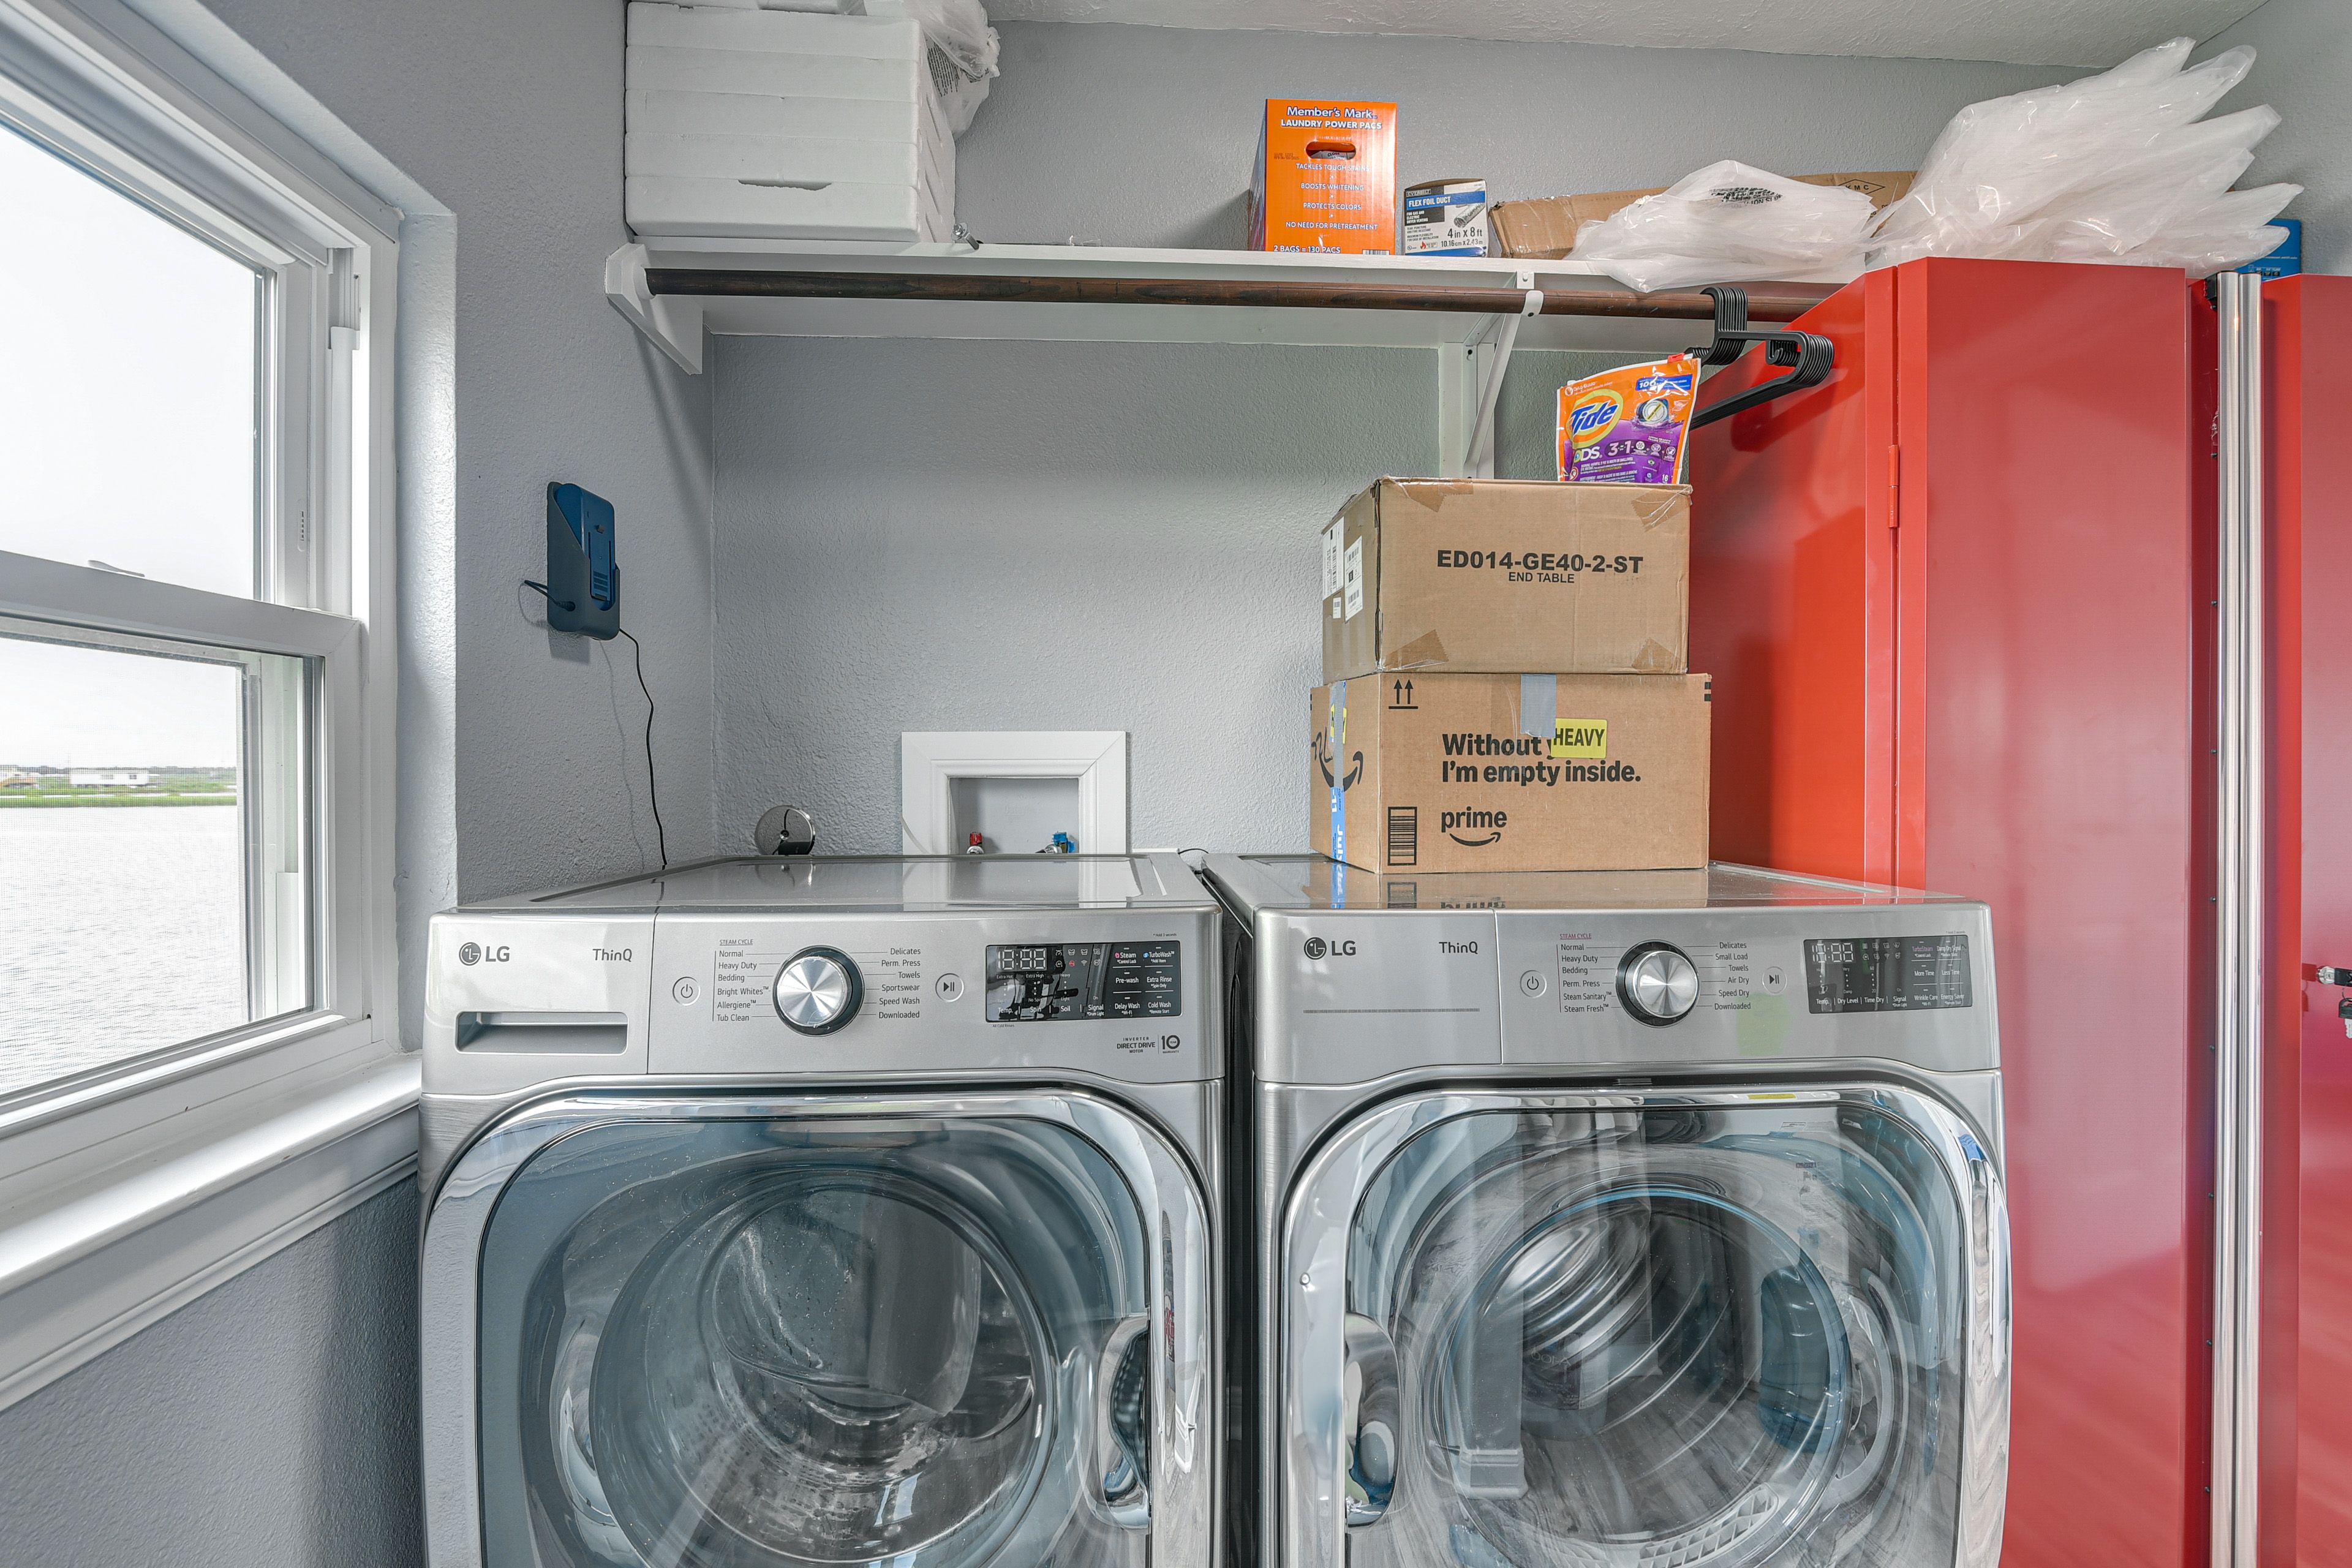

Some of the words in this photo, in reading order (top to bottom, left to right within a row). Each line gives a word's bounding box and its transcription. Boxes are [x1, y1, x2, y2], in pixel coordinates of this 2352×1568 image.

[1287, 106, 1340, 117] Member's
[1409, 199, 1422, 208] FLEX
[1448, 228, 1453, 238] 4
[1470, 227, 1475, 237] 8
[1570, 400, 1619, 436] Tide
[1437, 549, 1643, 574] ED014-GE40-2-ST
[1509, 571, 1532, 582] END
[1537, 572, 1575, 584] TABLE
[1555, 728, 1605, 747] HEAVY
[1442, 733, 1542, 756] Without
[1442, 761, 1477, 782] I'm
[1483, 763, 1560, 786] empty
[1566, 760, 1642, 782] inside.
[1441, 807, 1507, 833] prime
[1332, 940, 1356, 956] LG
[1439, 941, 1478, 955] ThinQ
[486, 946, 510, 963] LG
[592, 948, 633, 963] ThinQ
[1583, 955, 1598, 963] Duty
[718, 962, 739, 971] Heavy
[741, 962, 757, 970] Duty
[1562, 967, 1588, 975] Bedding
[718, 974, 745, 983] Bedding
[1738, 976, 1749, 985] Dry
[717, 988, 738, 997] Bright
[881, 984, 920, 993] Sportswear
[1738, 989, 1750, 998] Dry
[879, 997, 900, 1006] Speed
